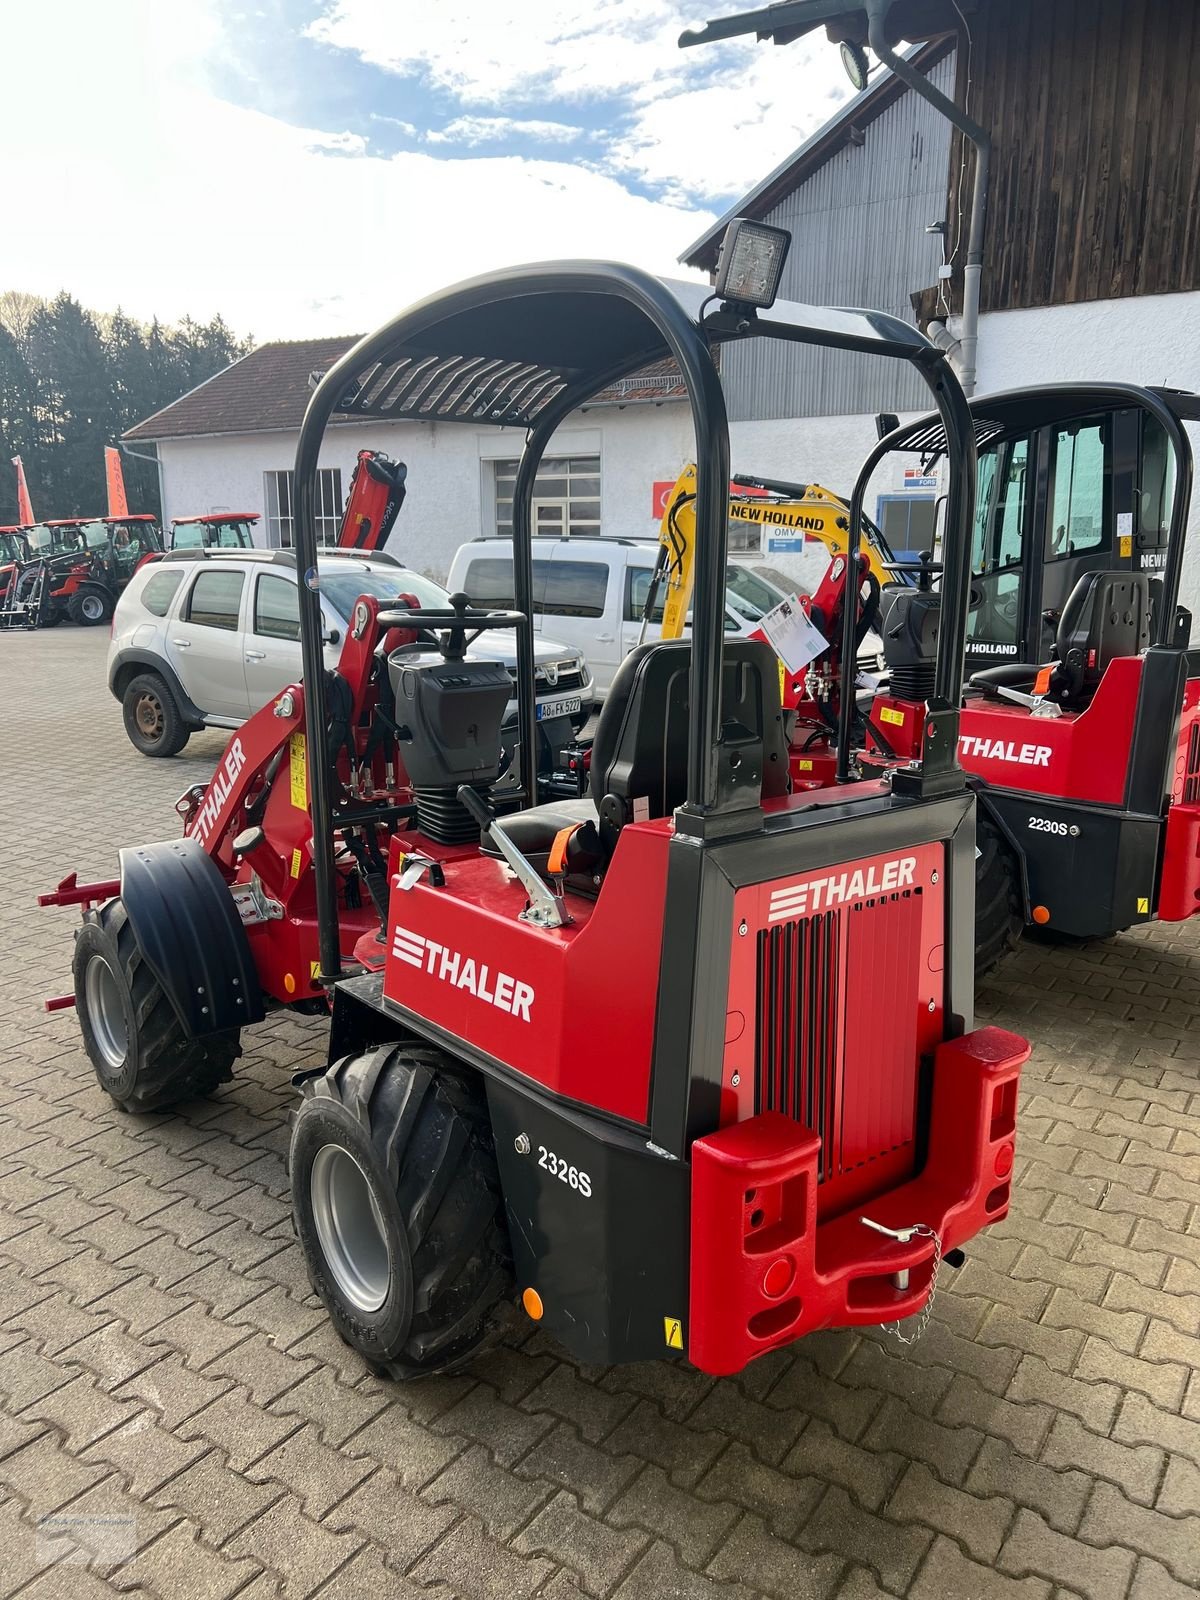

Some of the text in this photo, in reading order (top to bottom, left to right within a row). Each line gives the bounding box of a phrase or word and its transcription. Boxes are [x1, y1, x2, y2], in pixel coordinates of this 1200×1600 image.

[730, 504, 825, 531] NEW HOLLAND
[774, 528, 797, 537] OMV
[1140, 553, 1162, 568] NEW
[971, 643, 1018, 655] HOLLAND
[960, 735, 1053, 767] THALER
[198, 737, 247, 840] THALER
[1028, 816, 1068, 836] 2230S
[808, 856, 917, 911] THALER
[425, 938, 535, 1023] THALER
[538, 1145, 592, 1198] 2326S
